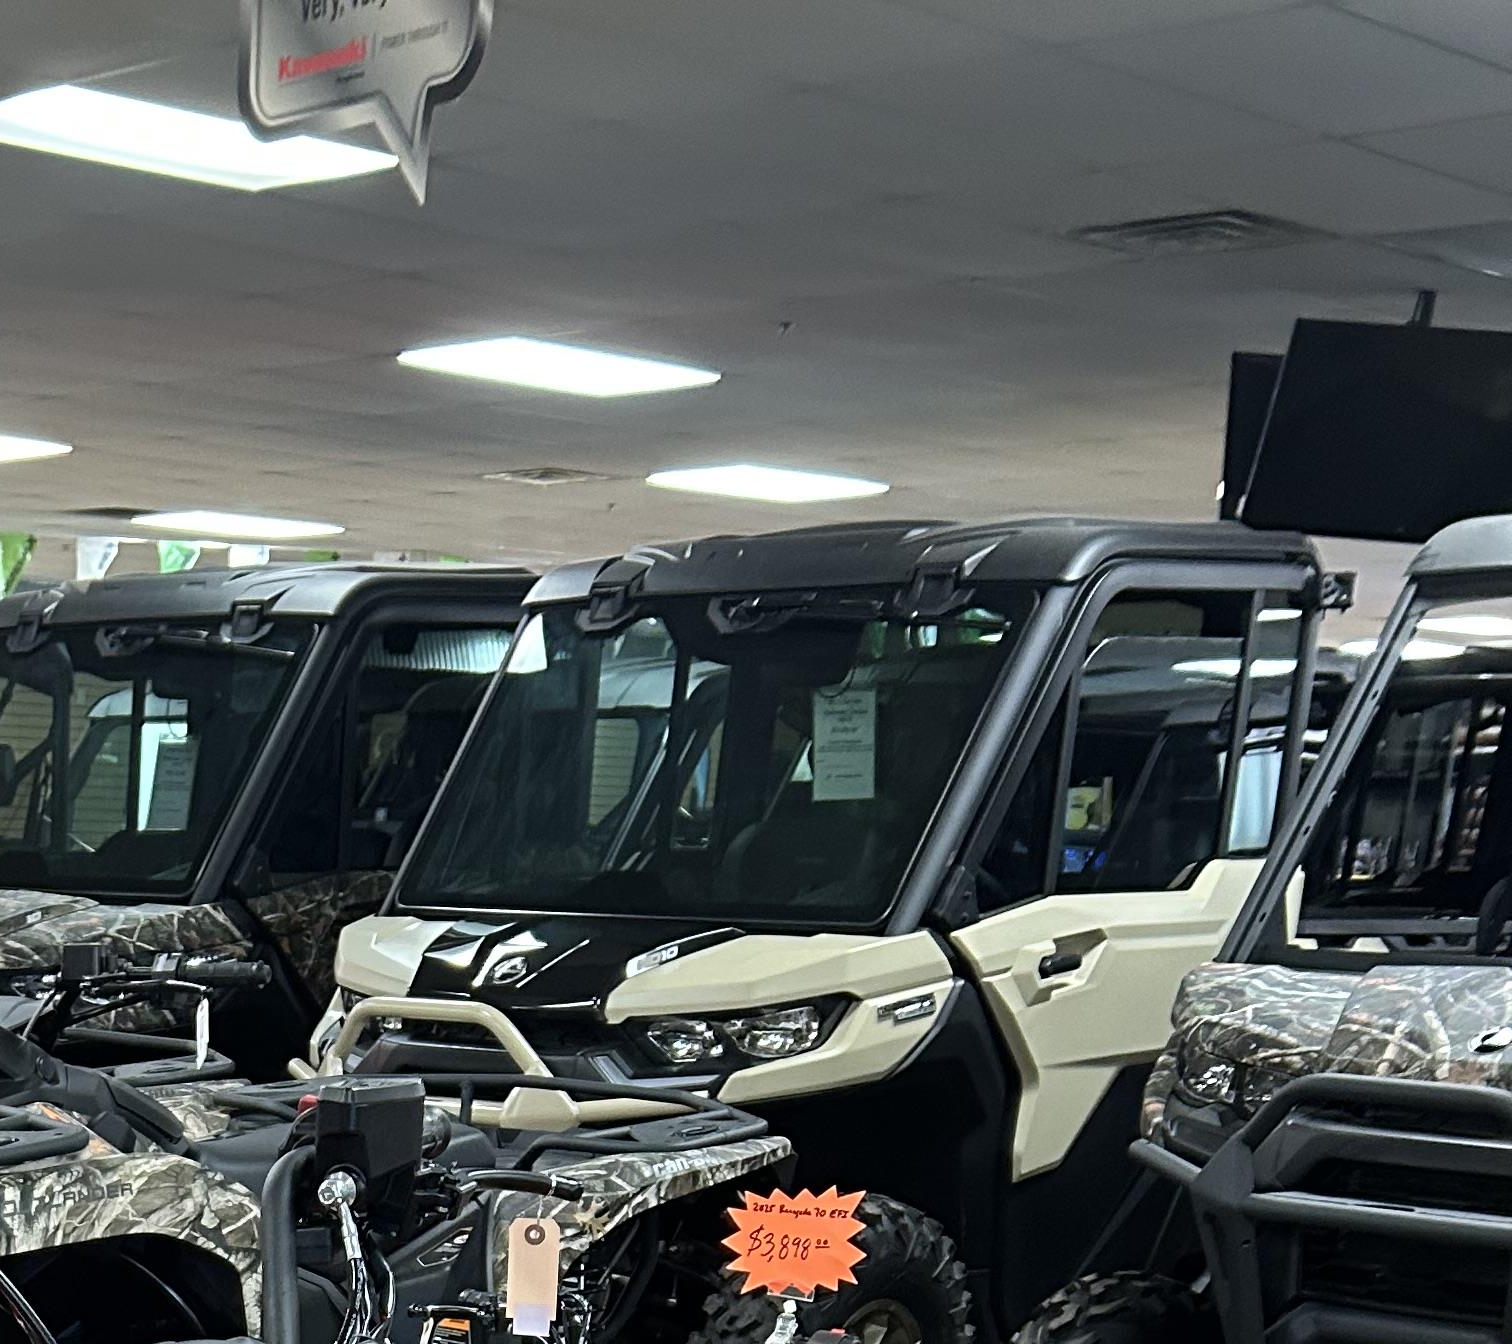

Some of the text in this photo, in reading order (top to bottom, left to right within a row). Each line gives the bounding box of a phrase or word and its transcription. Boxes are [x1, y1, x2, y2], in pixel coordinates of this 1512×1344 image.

[753, 1202, 776, 1214] 2025
[814, 1207, 827, 1218] 70
[829, 1209, 849, 1219] EFI
